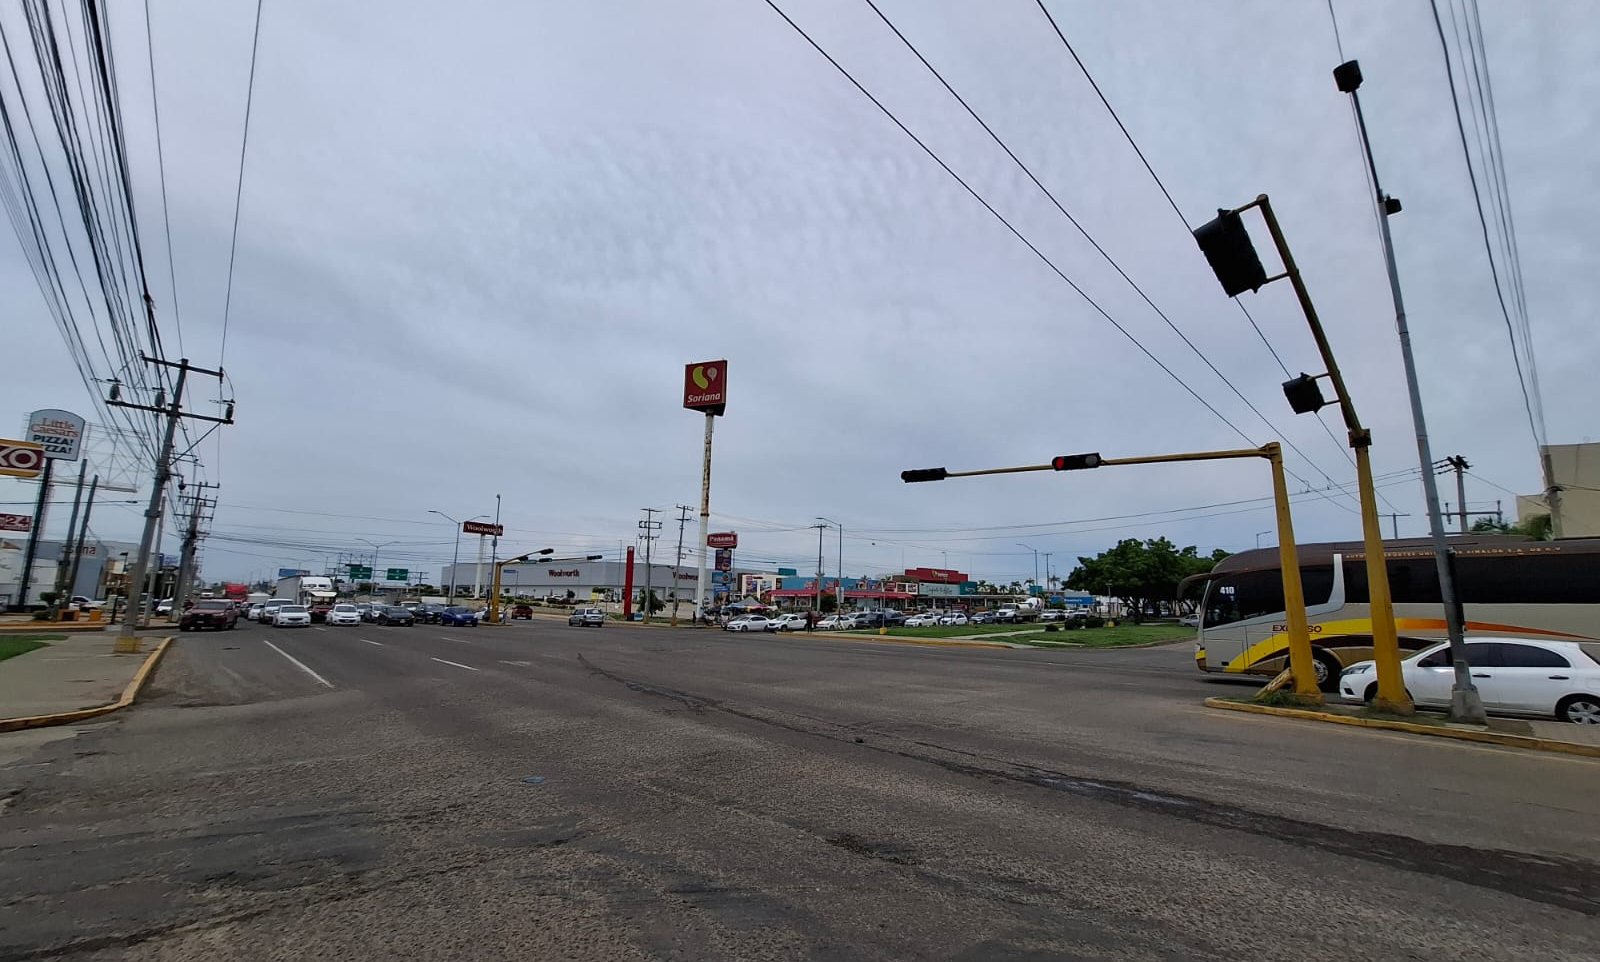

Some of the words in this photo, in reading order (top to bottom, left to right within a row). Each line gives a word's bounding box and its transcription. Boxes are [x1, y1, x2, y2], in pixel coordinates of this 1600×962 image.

[688, 393, 721, 403] Soriana
[41, 417, 76, 429] Little
[31, 424, 80, 437] Caesars
[33, 434, 74, 446] PIZZA!
[41, 444, 73, 455] ZZA!
[7, 515, 31, 527] 24
[466, 524, 503, 534] Woolworh
[548, 569, 580, 577] Woolworth
[1220, 586, 1235, 595] 410
[1272, 625, 1322, 633] EXSO
